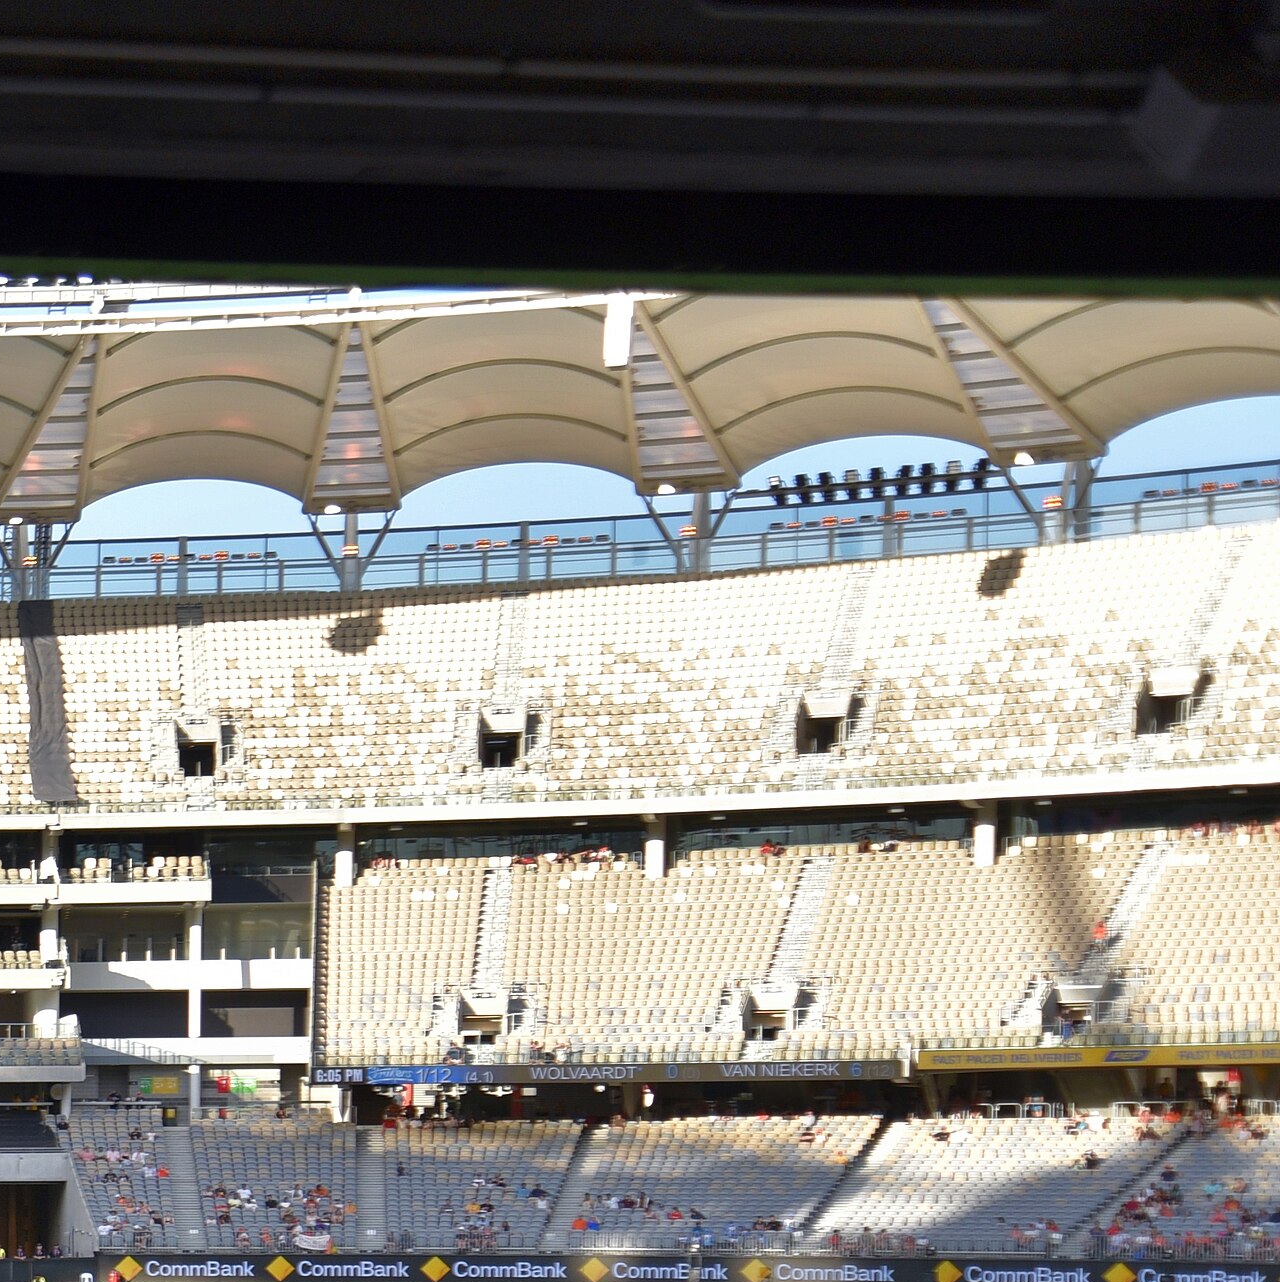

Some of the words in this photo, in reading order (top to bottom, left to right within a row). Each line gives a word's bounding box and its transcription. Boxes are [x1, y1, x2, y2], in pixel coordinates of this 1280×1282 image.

[932, 1054, 962, 1064] FAST
[967, 1053, 1006, 1064] PACED
[1011, 1052, 1082, 1063] DELIVERIES
[1216, 1050, 1257, 1060] PACED
[316, 1069, 342, 1082] 6:05
[346, 1069, 363, 1082] PM
[416, 1068, 452, 1083] 1/12
[667, 1064, 678, 1079] 0
[720, 1064, 759, 1077] VAN
[762, 1063, 841, 1077] NIEKERK
[849, 1063, 862, 1077] 6
[145, 1260, 255, 1278] CommBank
[298, 1260, 409, 1278] CommBank
[452, 1260, 568, 1279] CommBank
[774, 1263, 894, 1282] CommBank
